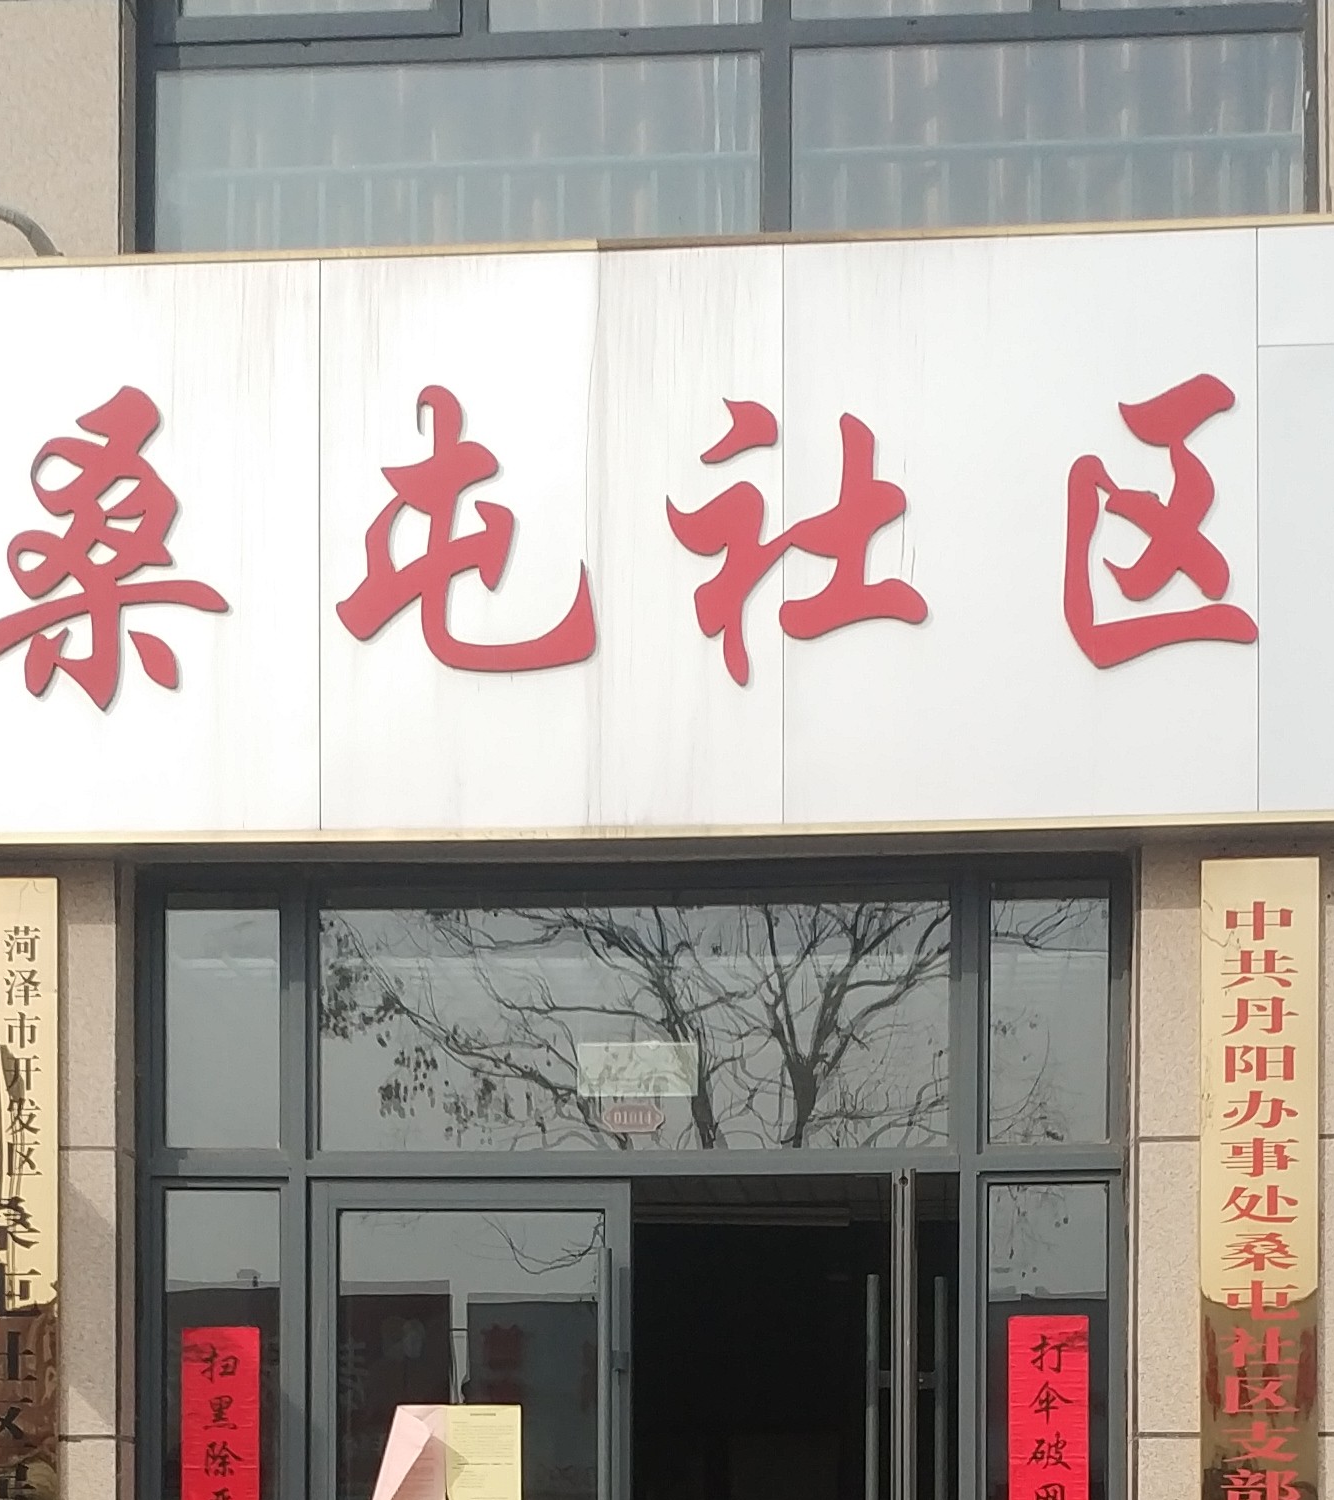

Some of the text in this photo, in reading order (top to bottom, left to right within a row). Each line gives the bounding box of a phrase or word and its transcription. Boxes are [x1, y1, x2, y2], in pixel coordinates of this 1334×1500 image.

[3, 925, 42, 1178] 菏泽市开发区
